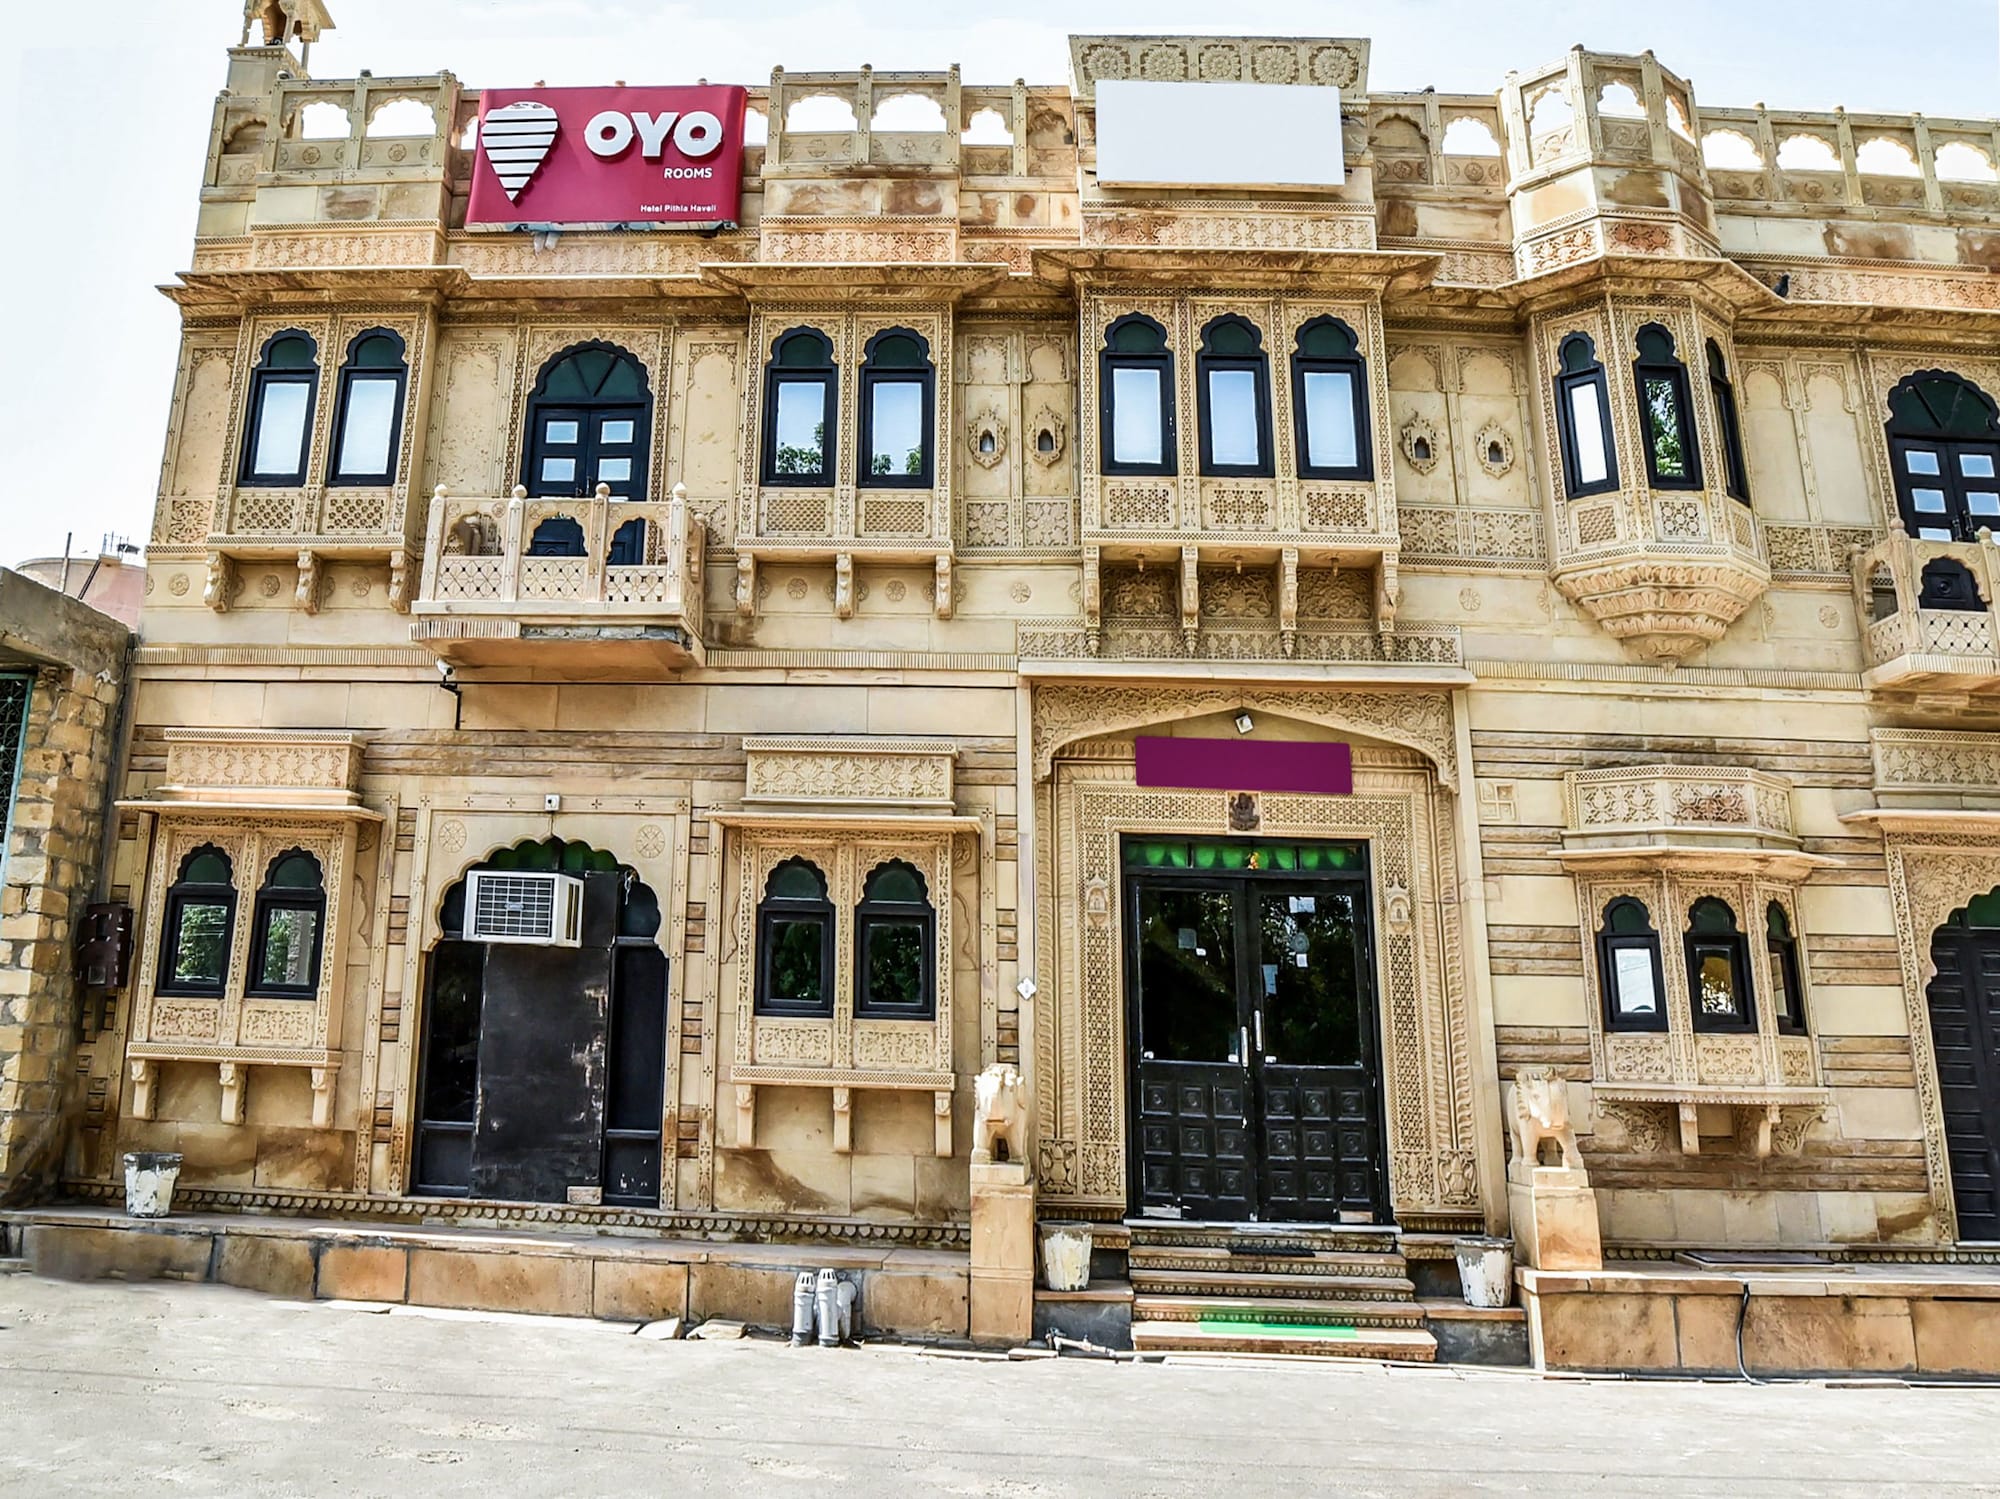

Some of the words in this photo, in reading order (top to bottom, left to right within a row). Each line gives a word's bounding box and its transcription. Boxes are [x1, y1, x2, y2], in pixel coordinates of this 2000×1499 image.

[584, 110, 723, 157] OYO
[663, 167, 713, 179] ROOMS
[640, 204, 663, 213] Hotel
[690, 204, 717, 213] Haveli
